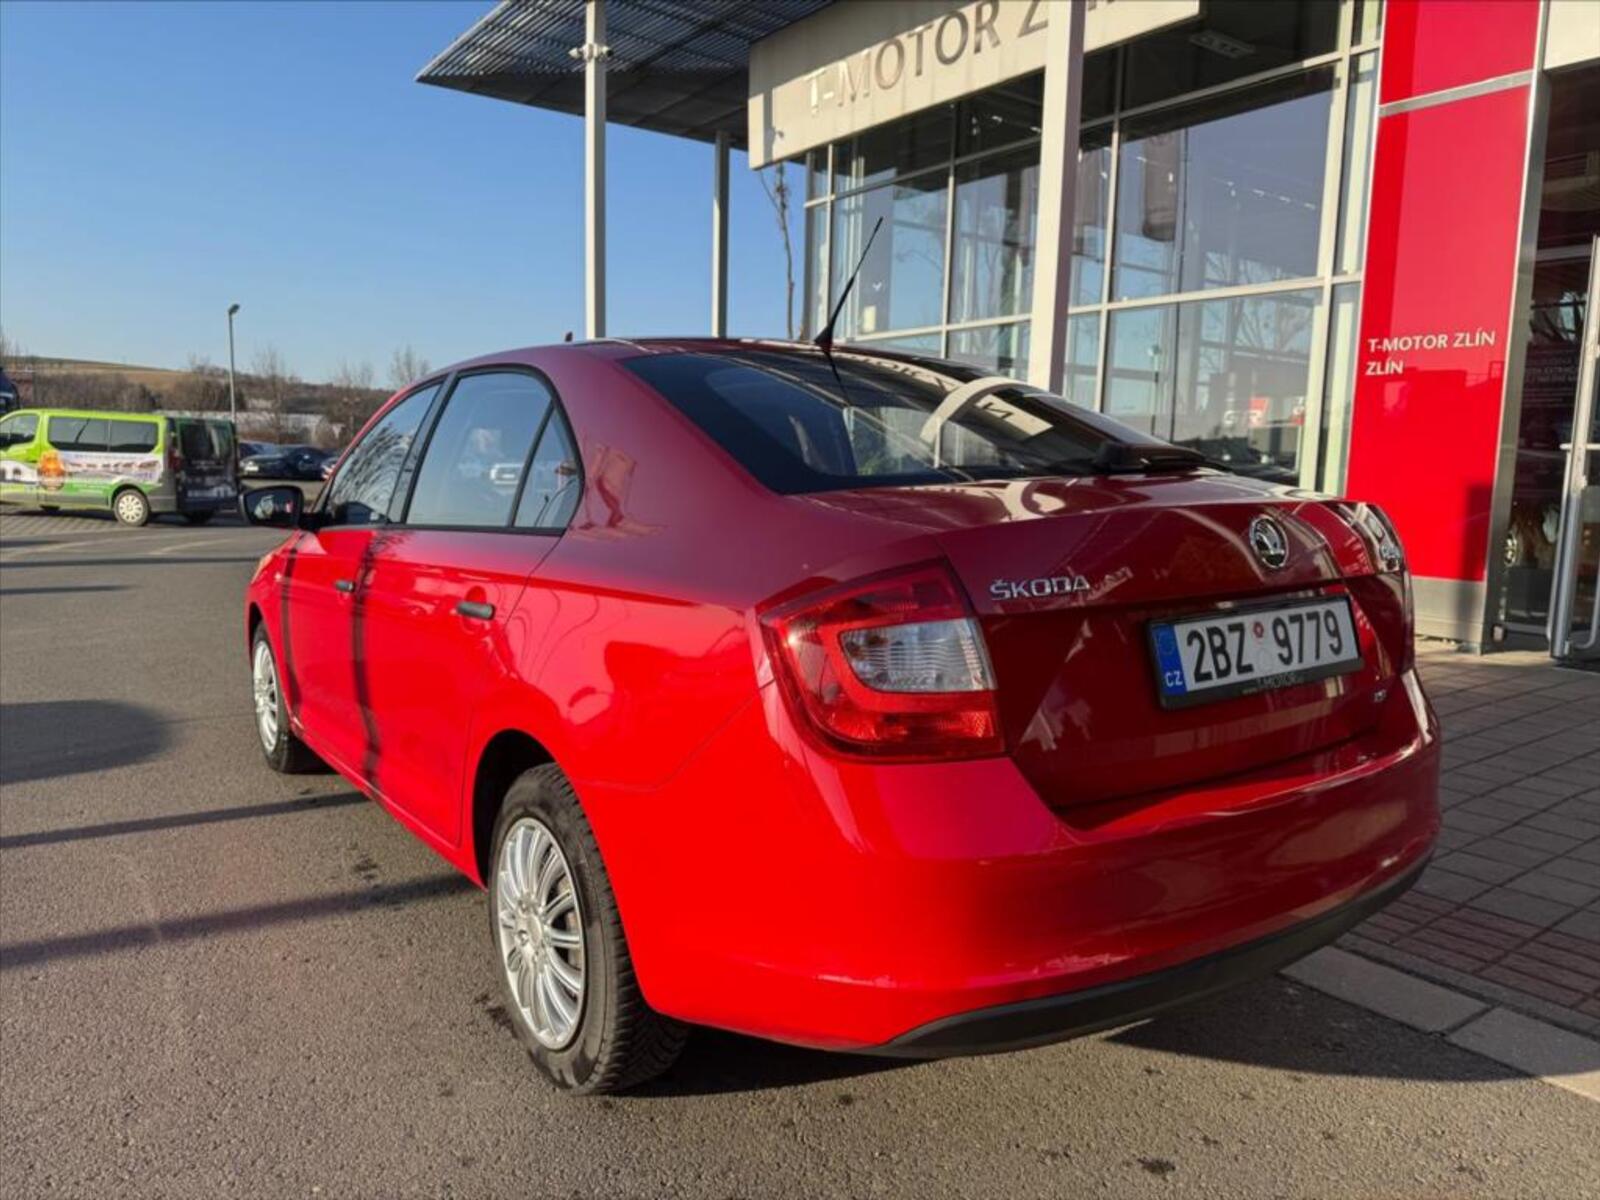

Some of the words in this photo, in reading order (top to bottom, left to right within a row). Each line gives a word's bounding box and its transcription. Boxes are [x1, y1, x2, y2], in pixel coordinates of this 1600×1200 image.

[804, 0, 1001, 115] T-MOTOR
[1367, 334, 1449, 353] T-MOTOR
[1453, 327, 1496, 348] ZLÍN
[1365, 357, 1404, 376] ZLÍN
[990, 575, 1091, 601] ŠKODA
[1186, 621, 1254, 683] 2BZ
[1272, 609, 1344, 666] 9779
[1164, 670, 1183, 687] CZ
